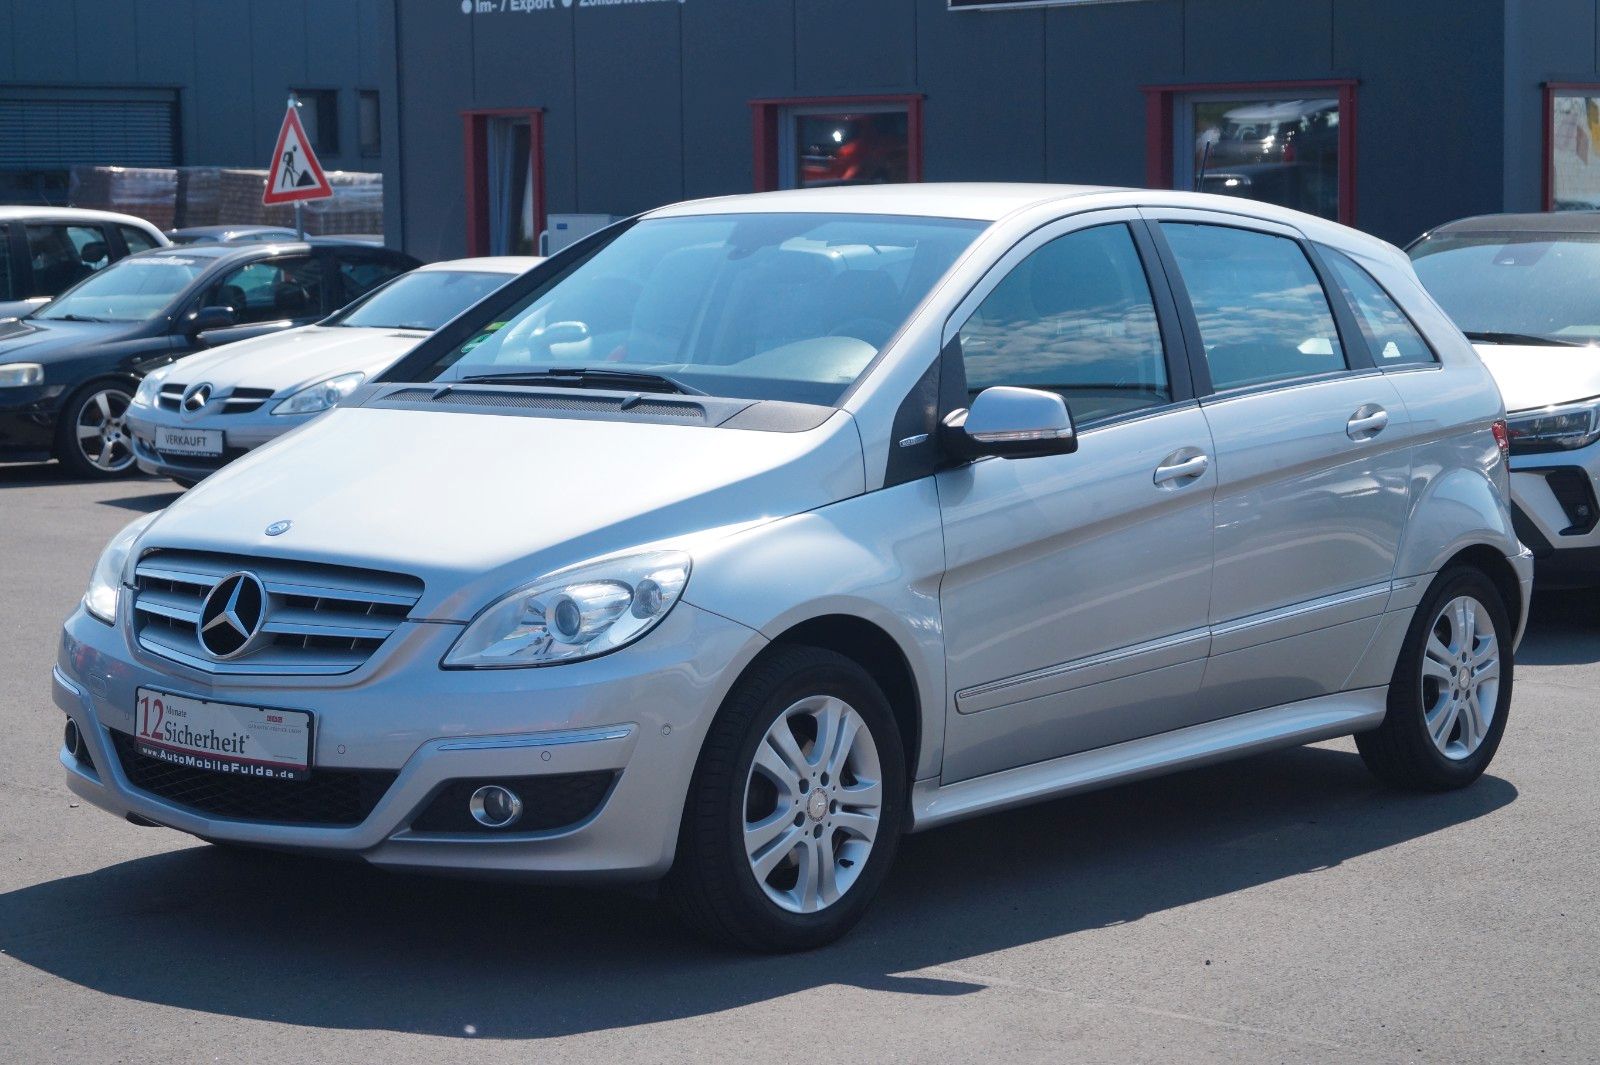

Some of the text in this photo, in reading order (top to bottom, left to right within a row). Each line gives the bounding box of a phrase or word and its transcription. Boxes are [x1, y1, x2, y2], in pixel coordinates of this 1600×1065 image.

[510, 0, 555, 13] Export
[165, 434, 207, 447] VERKAUFT
[166, 705, 187, 718] Monate
[139, 696, 164, 741] 12
[142, 747, 294, 780] www.AutoMobileFulda.de
